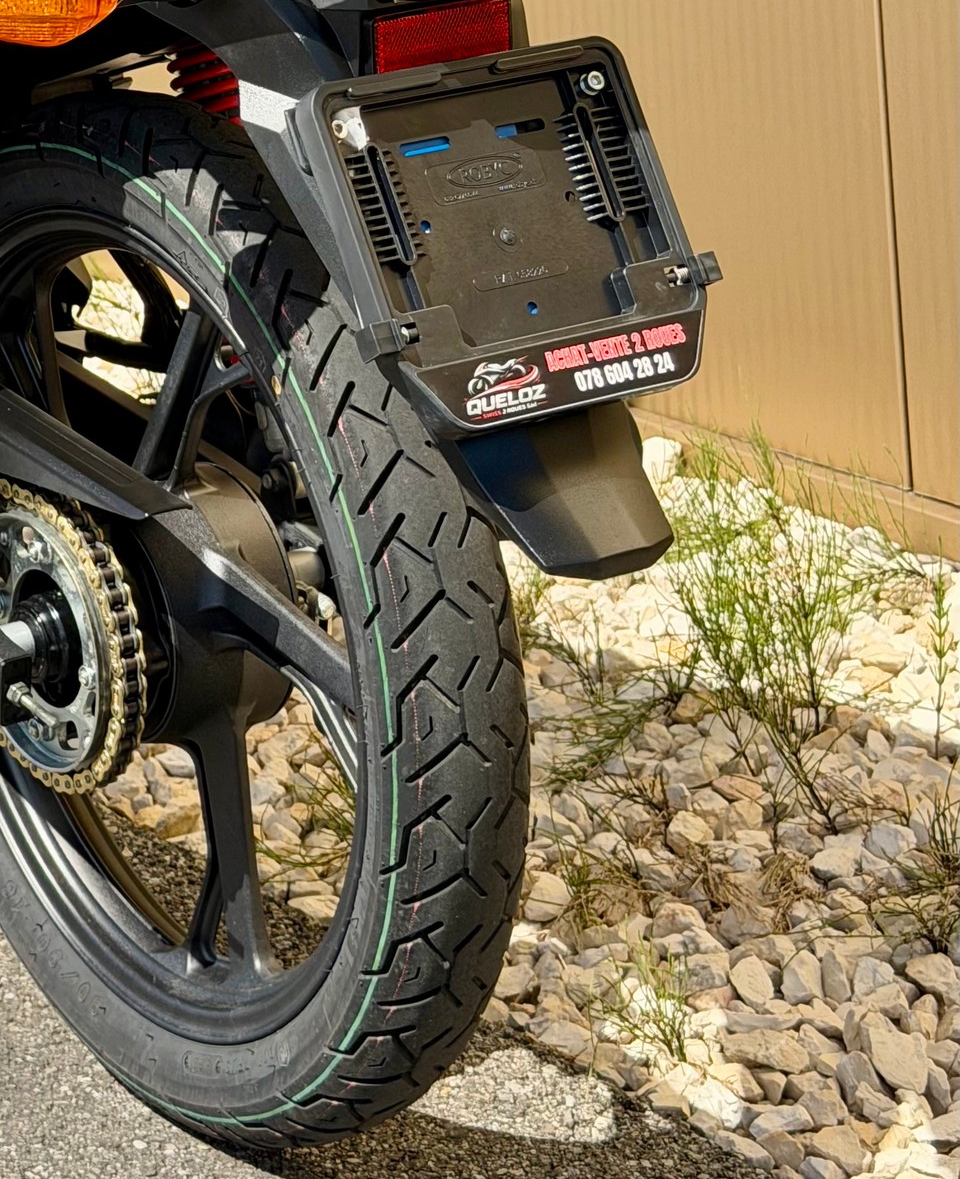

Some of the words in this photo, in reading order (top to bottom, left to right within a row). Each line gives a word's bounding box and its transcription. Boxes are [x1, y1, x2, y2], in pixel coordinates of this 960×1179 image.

[544, 334, 632, 373] ACHAT-VENTE
[630, 331, 644, 354] 2
[641, 323, 687, 352] ROUES
[574, 366, 604, 392] 078
[604, 360, 635, 385] 604
[633, 355, 657, 379] 28
[652, 351, 676, 376] 24
[466, 383, 547, 416] QUELOZ
